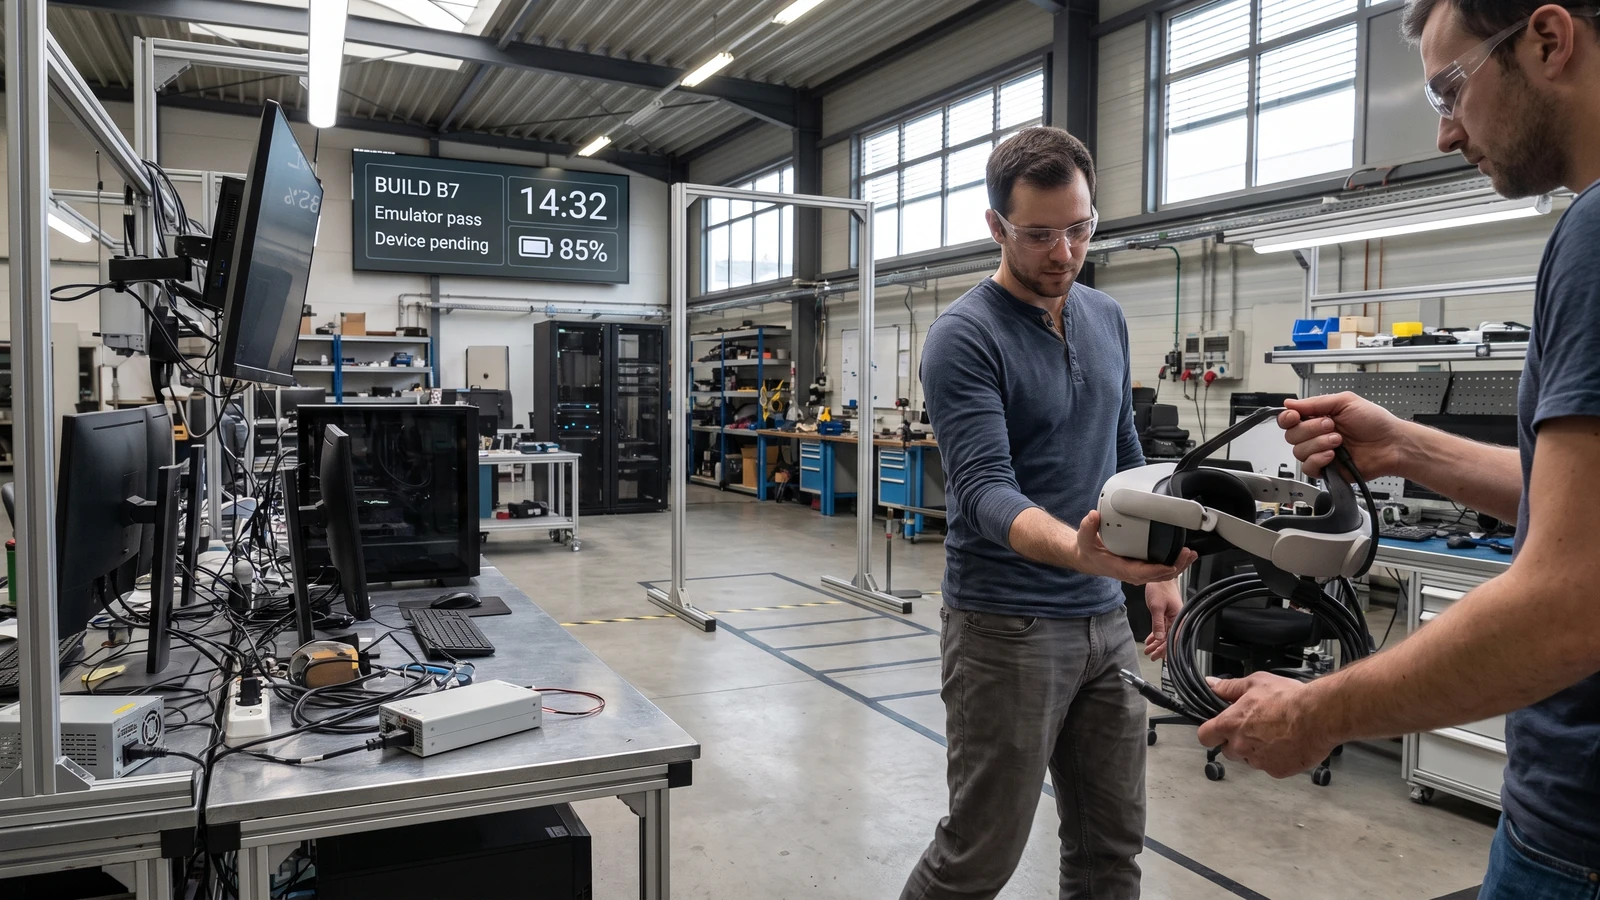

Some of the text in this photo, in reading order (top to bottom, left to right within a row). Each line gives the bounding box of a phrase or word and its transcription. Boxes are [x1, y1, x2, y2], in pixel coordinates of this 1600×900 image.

[375, 176, 460, 199] BUILD B7
[520, 186, 608, 221] 14:32
[375, 205, 482, 228] Emulator pass
[375, 231, 489, 255] Device pending
[559, 238, 608, 263] 85%
